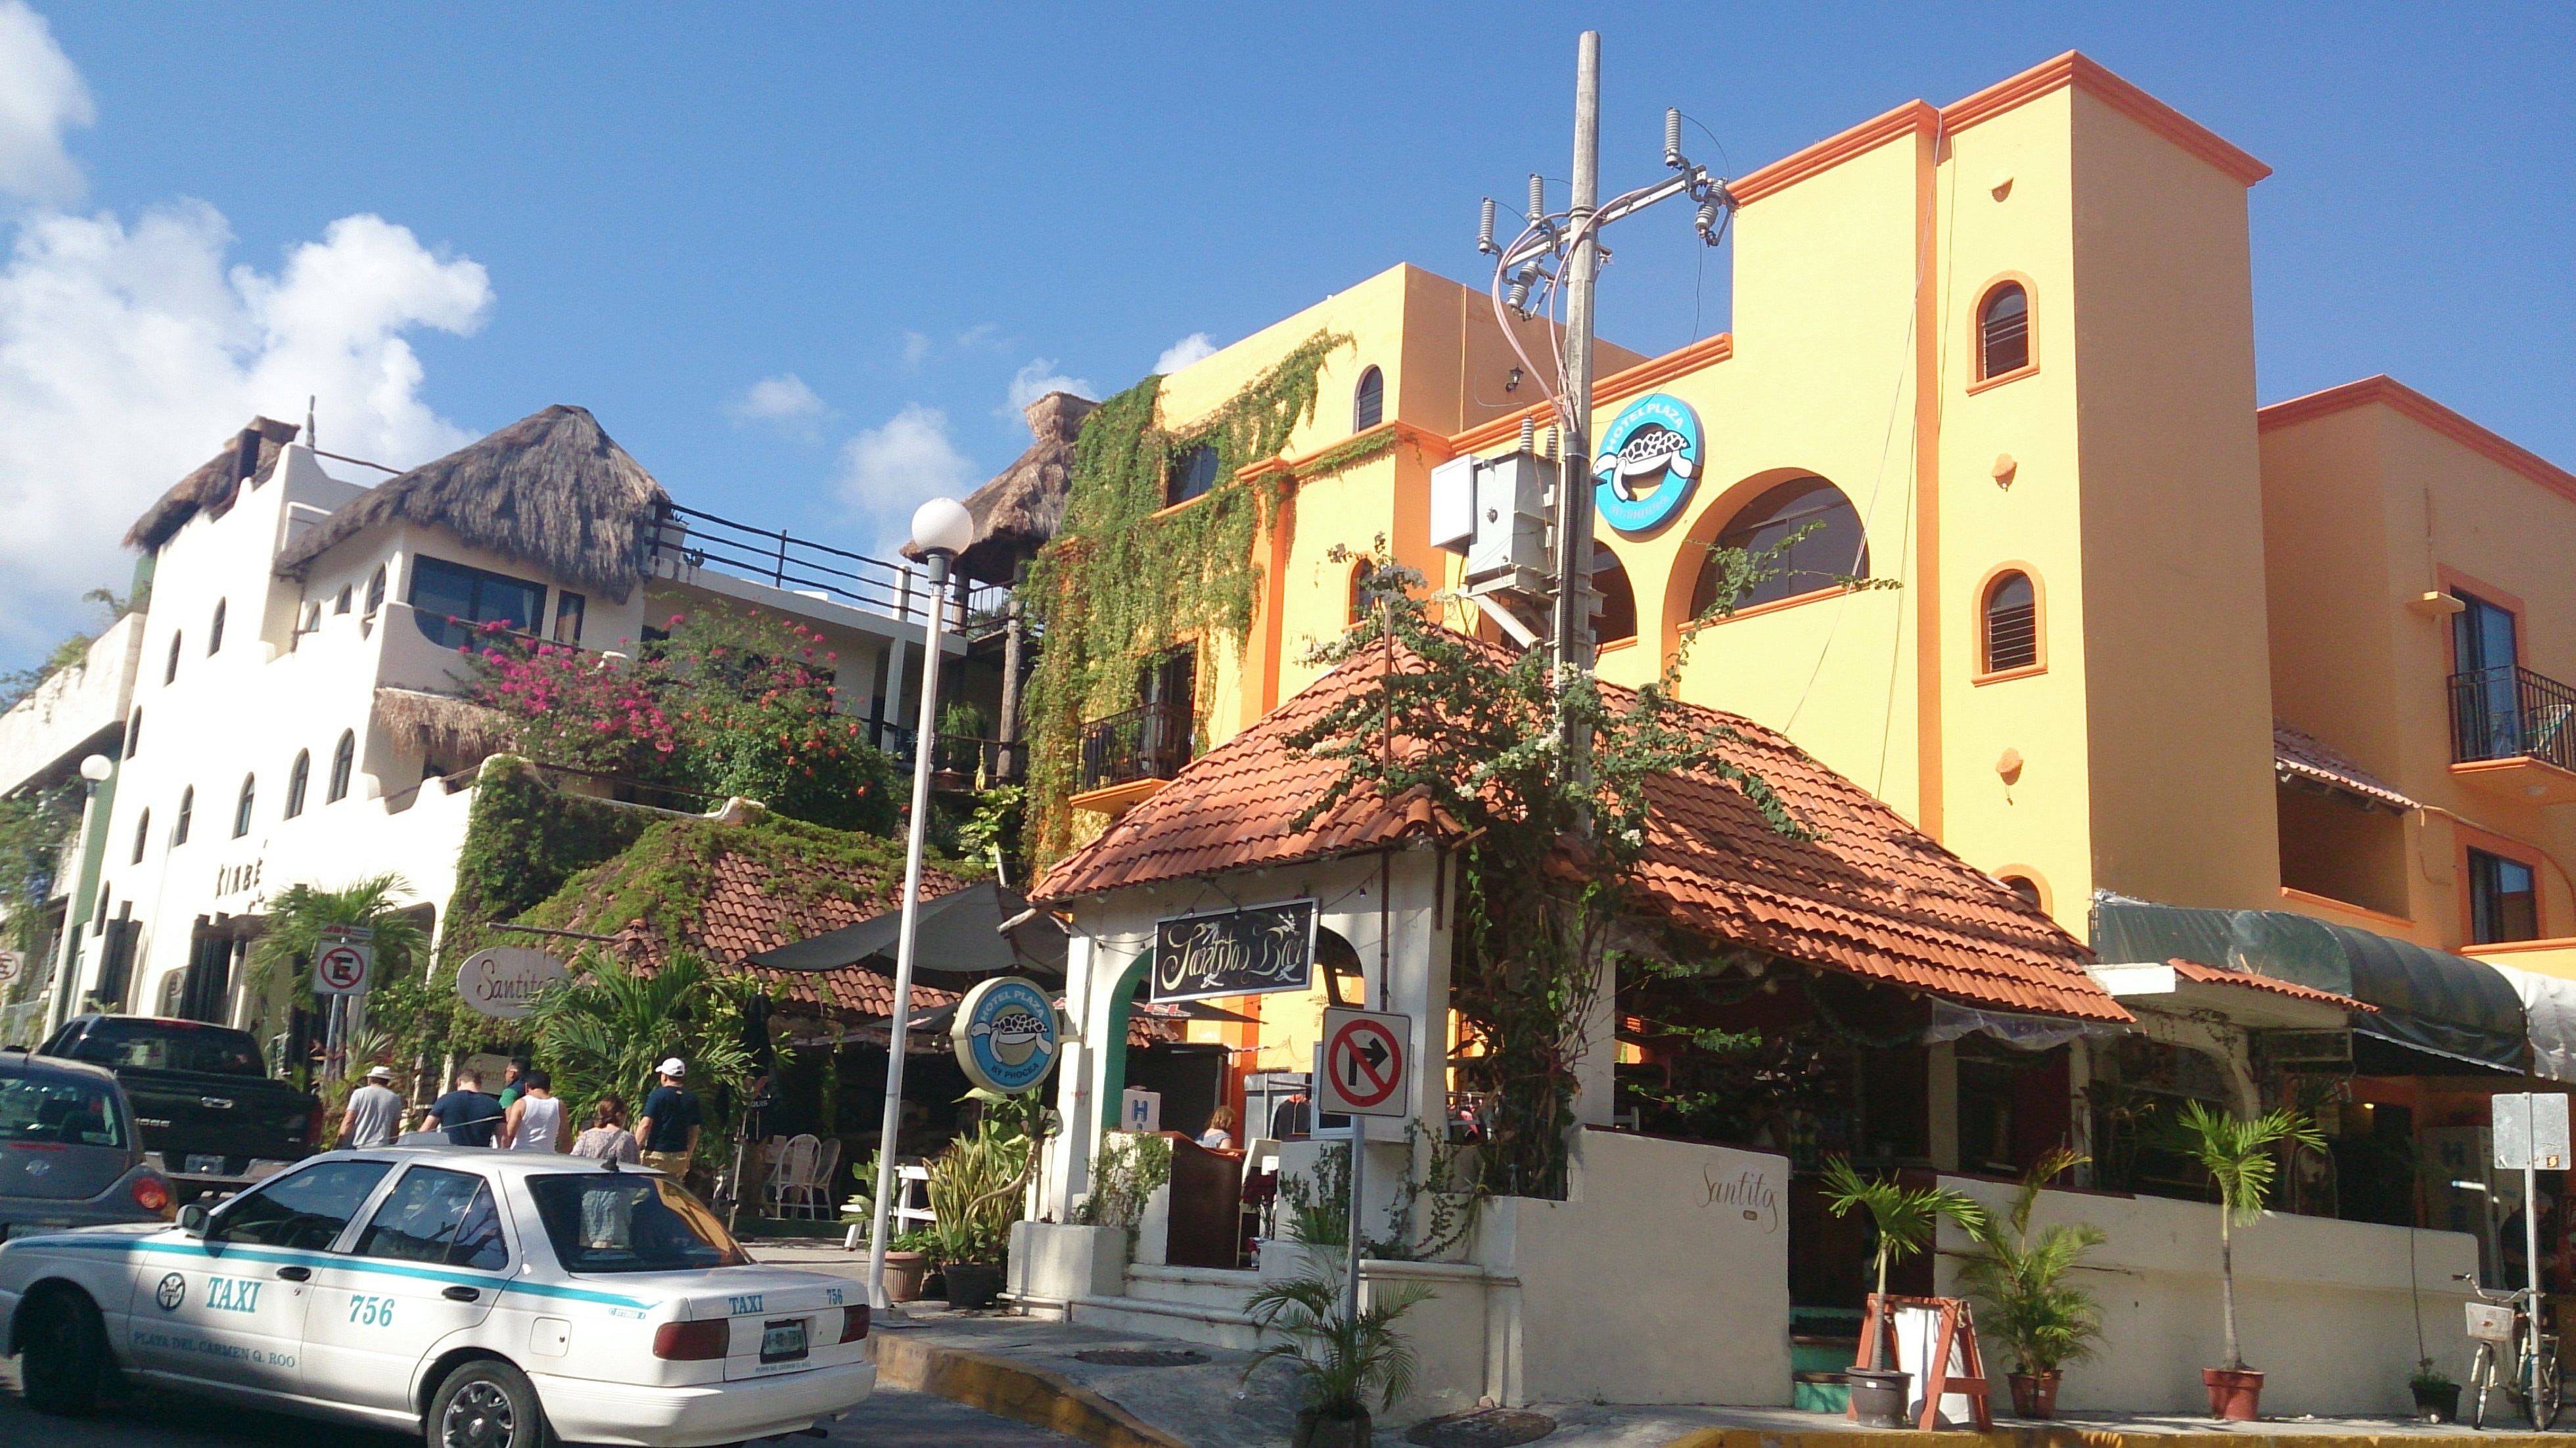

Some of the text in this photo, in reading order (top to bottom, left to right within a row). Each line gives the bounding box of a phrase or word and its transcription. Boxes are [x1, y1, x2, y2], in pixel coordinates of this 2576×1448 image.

[1606, 403, 1683, 451] HOTEL PLAZA
[1161, 923, 1304, 991] Santitos Bar
[981, 990, 1044, 1021] HOTEL PLAZA
[991, 1062, 1040, 1079] BY PHOCEA
[1693, 1163, 1778, 1234] Santitos
[206, 1277, 262, 1313] TAXI
[350, 1294, 395, 1327] 756
[729, 1294, 764, 1315] TAXI
[827, 1288, 842, 1305] 756
[198, 1341, 249, 1361] CARMEN
[269, 1352, 296, 1369] ROO
